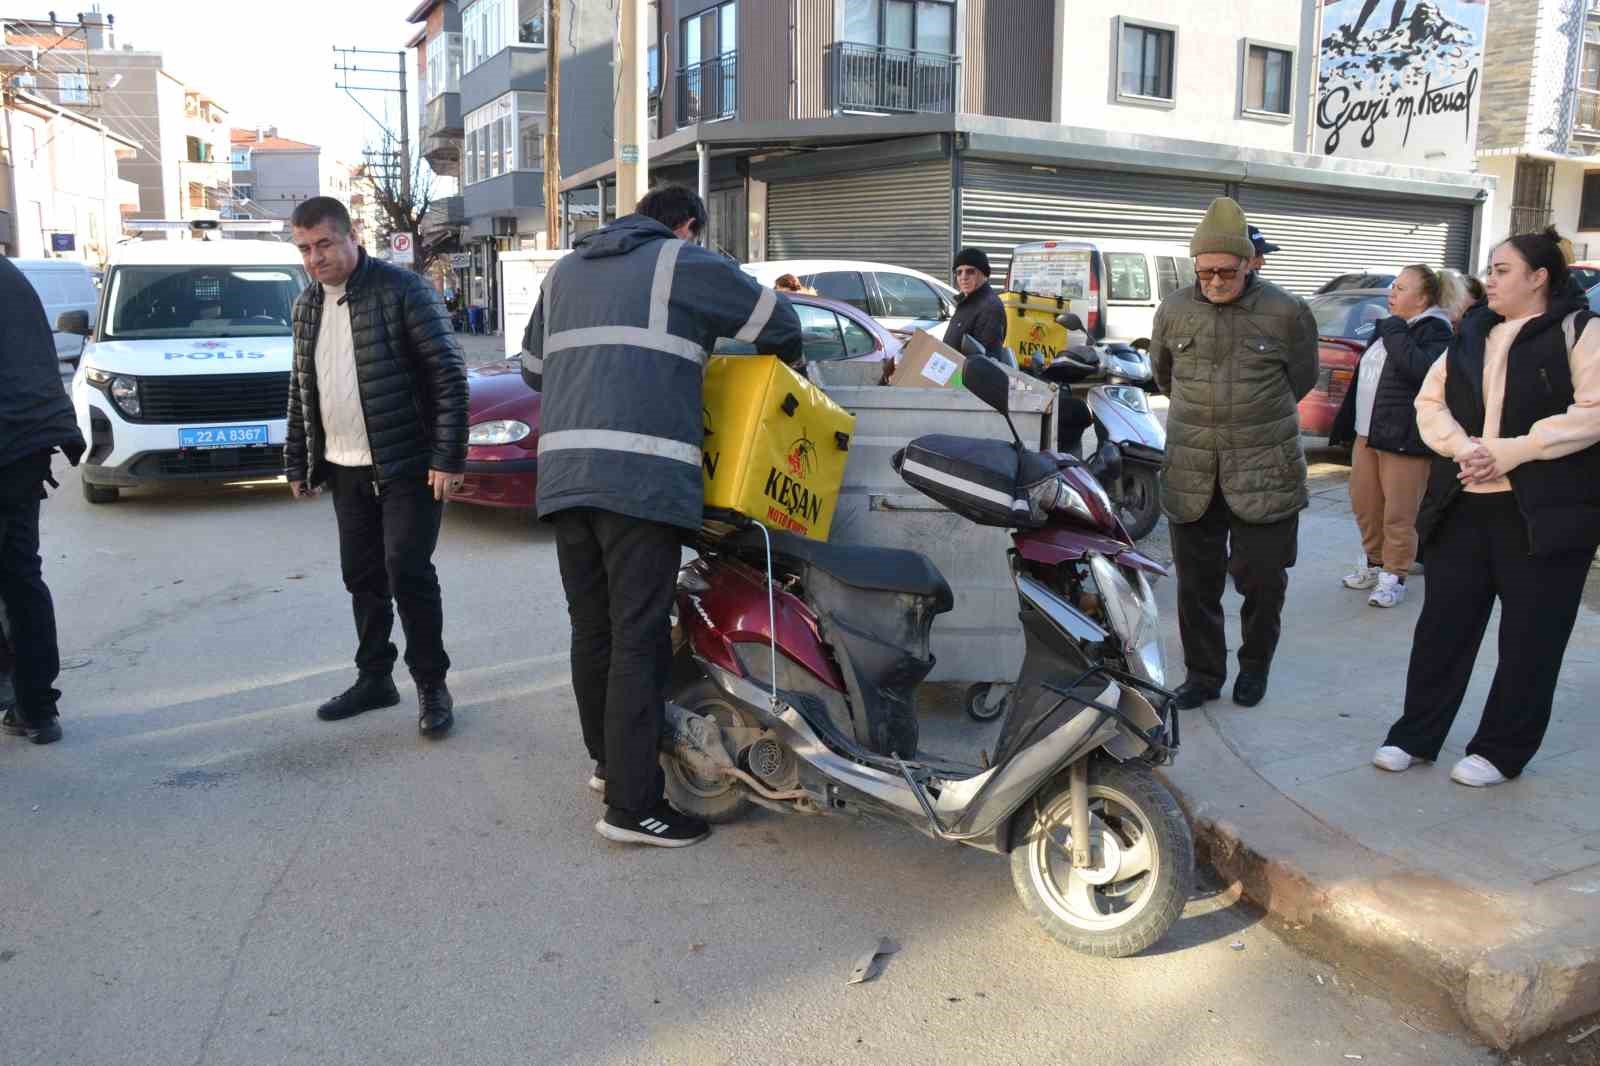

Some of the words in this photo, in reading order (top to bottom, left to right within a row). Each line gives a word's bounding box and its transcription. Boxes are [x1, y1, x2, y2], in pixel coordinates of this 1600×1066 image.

[1317, 86, 1390, 155] Gazi
[197, 430, 213, 442] 22
[215, 430, 227, 442] A
[230, 428, 261, 441] 8367
[764, 466, 823, 525] KEŞAN
